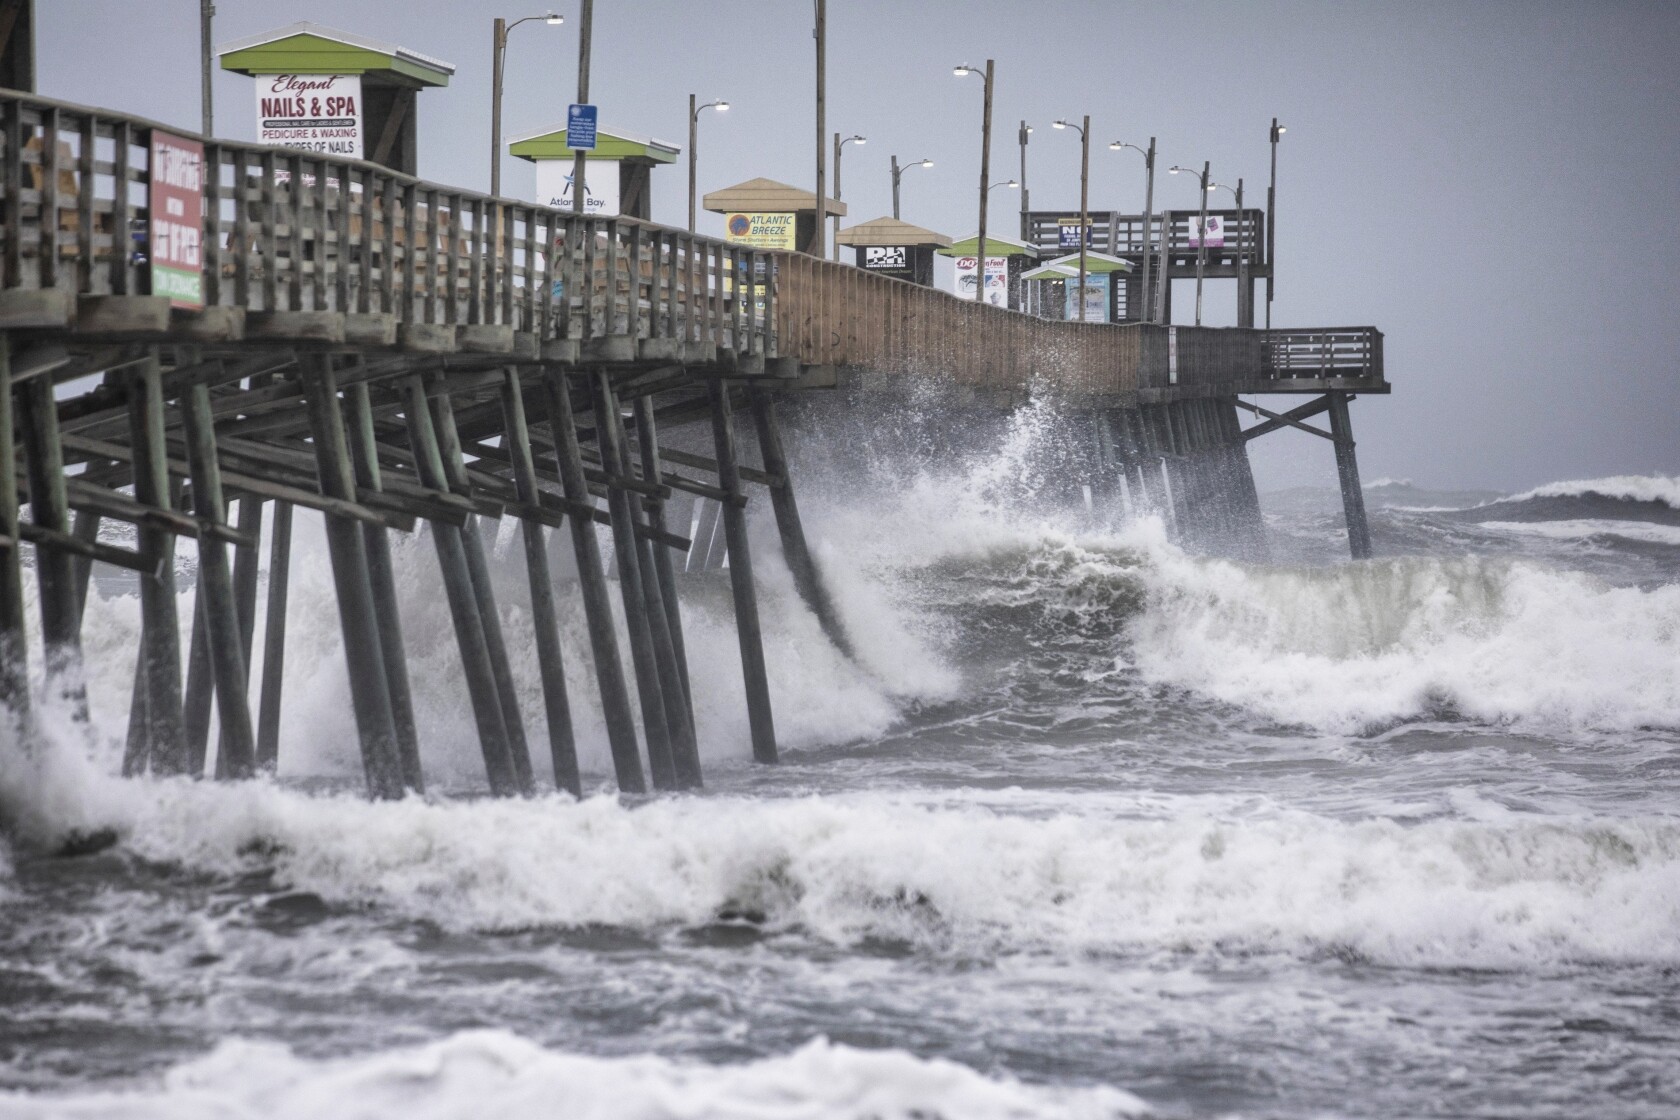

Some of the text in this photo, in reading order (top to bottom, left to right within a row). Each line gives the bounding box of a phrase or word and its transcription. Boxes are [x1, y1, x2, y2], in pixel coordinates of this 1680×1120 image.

[272, 75, 344, 97] Elegant
[261, 96, 356, 117] NAILS & SPA
[262, 128, 357, 139] PEDICURE & WAXING
[315, 141, 326, 152] OF
[329, 141, 354, 153] NAILS
[750, 215, 792, 224] ATLANTIC
[752, 226, 786, 234] BREEZE
[959, 259, 976, 269] DQ
